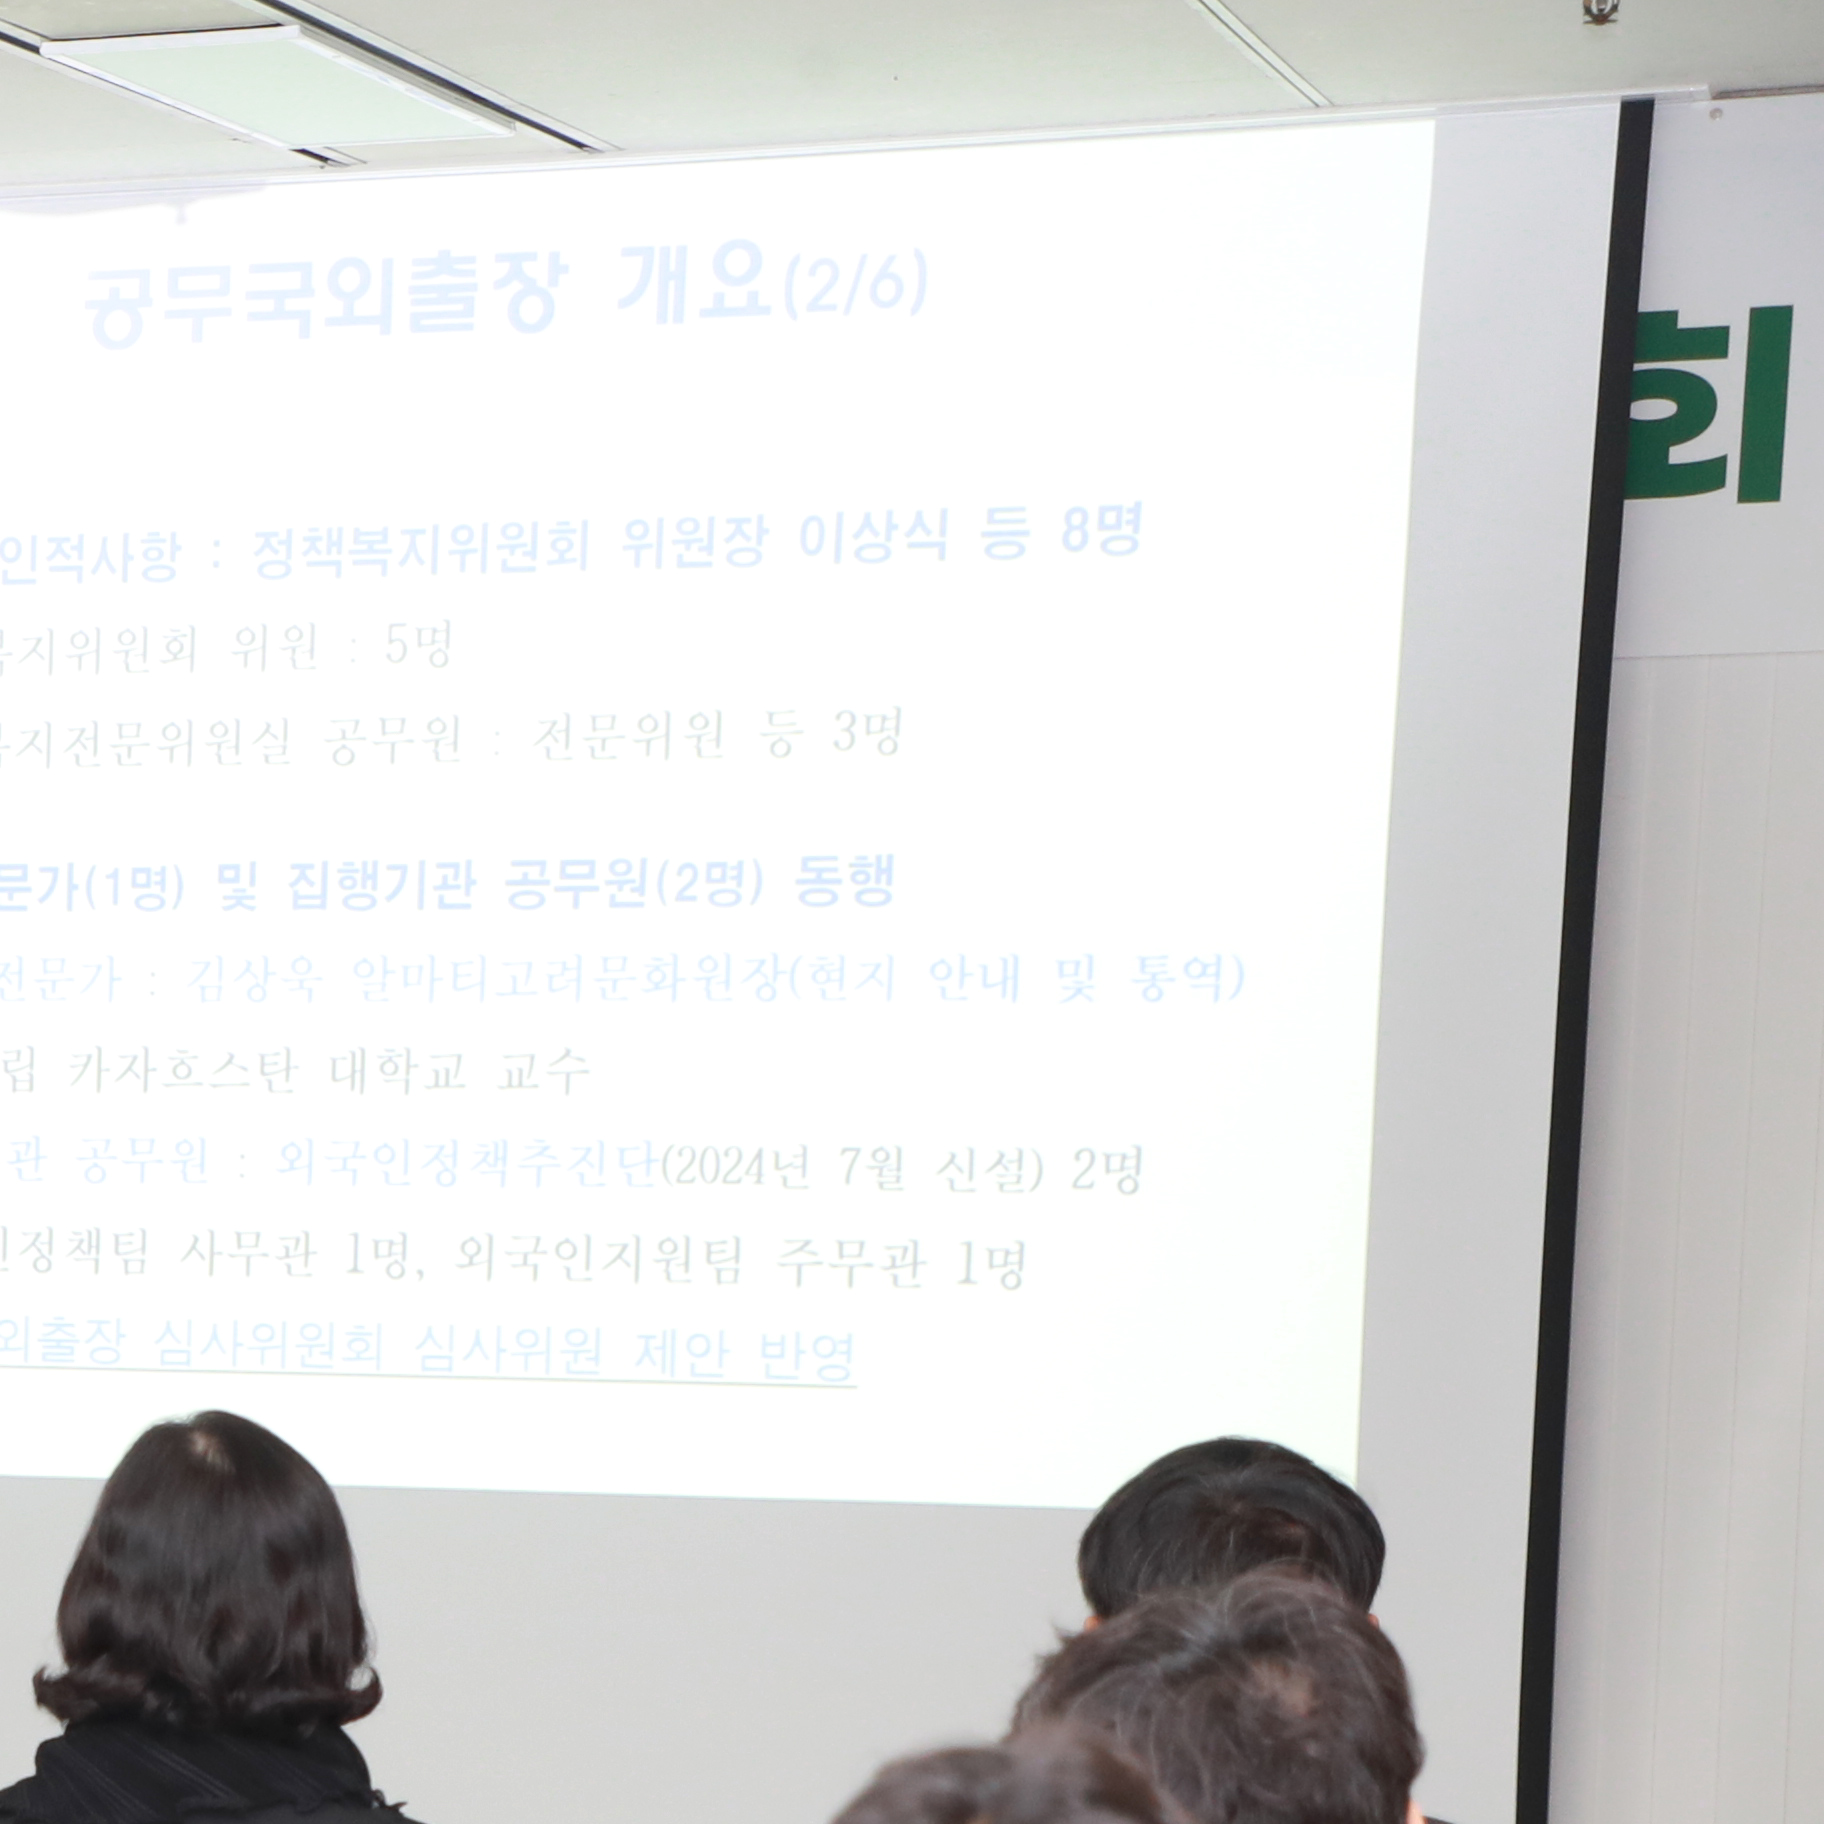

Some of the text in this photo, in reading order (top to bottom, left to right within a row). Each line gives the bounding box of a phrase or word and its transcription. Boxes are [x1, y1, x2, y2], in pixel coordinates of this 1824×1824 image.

[84, 238, 929, 350] 공무국외출장 개요(2/6)
[253, 518, 589, 581] 정책복지위원회
[622, 513, 771, 570] 위원장
[799, 506, 949, 565] 이상식
[979, 505, 1032, 561] 등
[1061, 499, 1144, 558] 8명
[231, 621, 317, 673] 위원
[385, 618, 452, 669] 5명
[324, 714, 460, 768] 공무원
[533, 708, 723, 762] 전문위원
[759, 709, 805, 760] 등
[832, 704, 903, 757] 3명
[217, 860, 257, 912] 및
[287, 858, 479, 913] 집행기관
[504, 856, 765, 911] 공무원(2명)
[794, 852, 895, 909] 동행
[188, 954, 324, 1004] 김상욱
[353, 951, 895, 1004] 알마티고려문화원장(현지
[929, 952, 1021, 1004] 안내
[1055, 952, 1097, 1004] 및
[1130, 952, 1247, 1005] 통역)
[69, 1045, 300, 1095] 카자흐스탄
[329, 1046, 467, 1096] 대학교
[497, 1046, 591, 1097] 교수
[76, 1136, 208, 1185] 공무원
[276, 1137, 810, 1191] 외국인정책추진단(2024년
[839, 1144, 905, 1193] 7월
[935, 1145, 1045, 1195] 신설)
[1070, 1143, 1145, 1197] 2명
[180, 1228, 319, 1278] 사무관
[346, 1230, 425, 1282] 1명,
[455, 1231, 743, 1287] 외국인지원팀
[776, 1238, 929, 1290] 주무관
[956, 1239, 1027, 1292] 1명
[152, 1318, 387, 1373] 심사위원회
[413, 1324, 606, 1378] 심사위원
[634, 1327, 734, 1382] 제안
[759, 1330, 856, 1385] 반영
